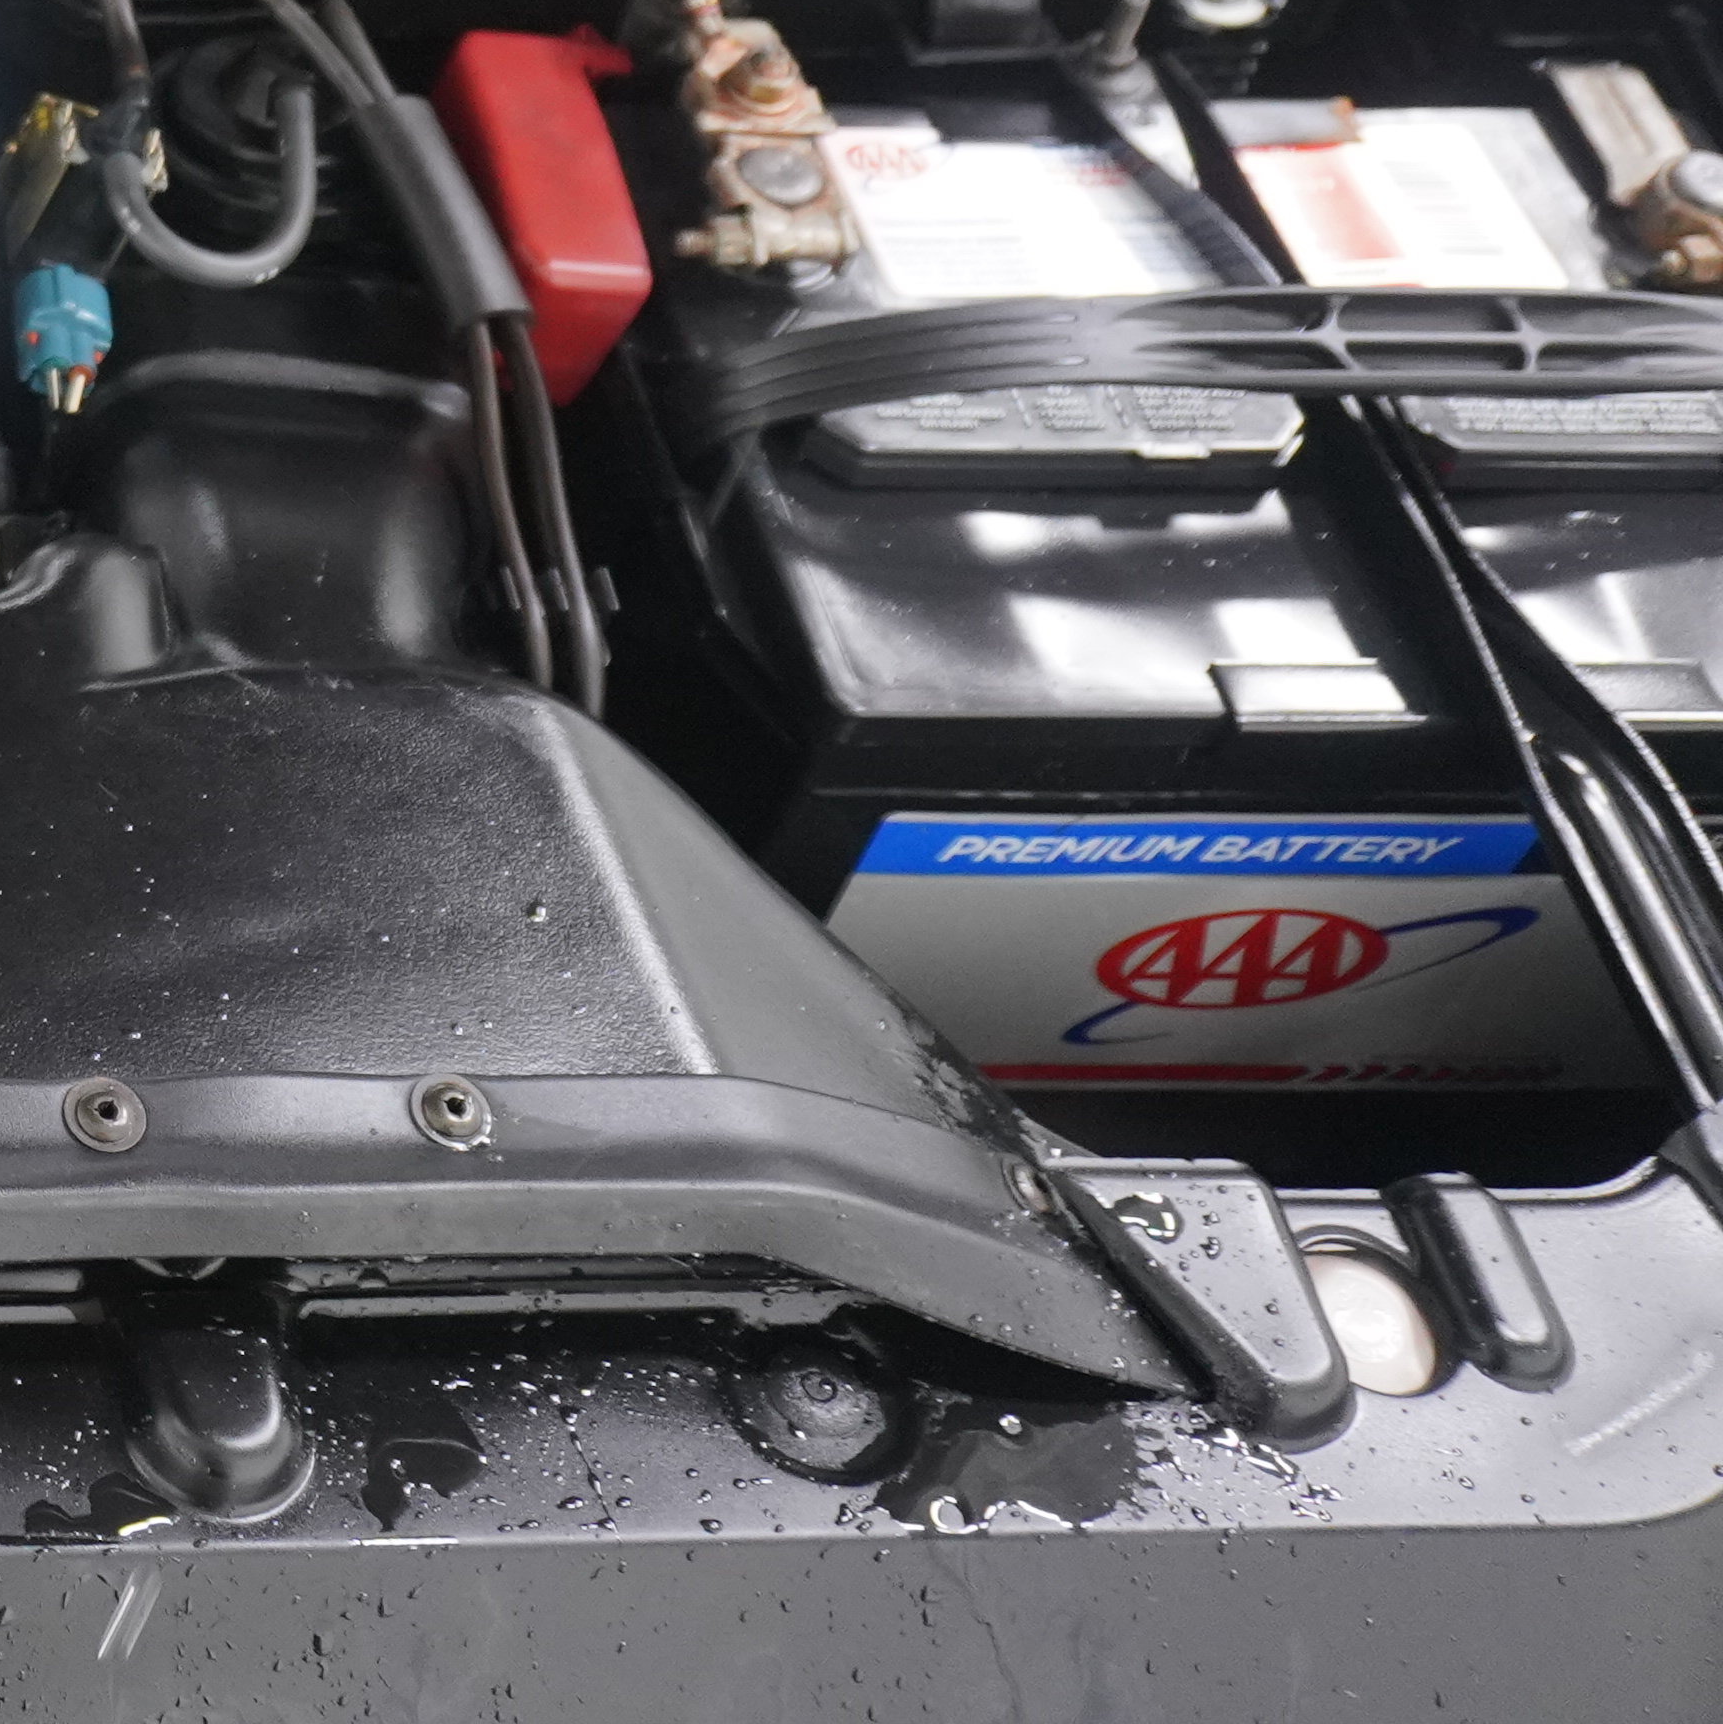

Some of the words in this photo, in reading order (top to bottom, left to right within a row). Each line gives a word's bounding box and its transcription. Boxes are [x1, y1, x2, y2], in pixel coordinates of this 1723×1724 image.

[937, 835, 1204, 864] PREMIUM
[1199, 835, 1462, 864] BATTERY
[1105, 908, 1370, 1009] AAA
